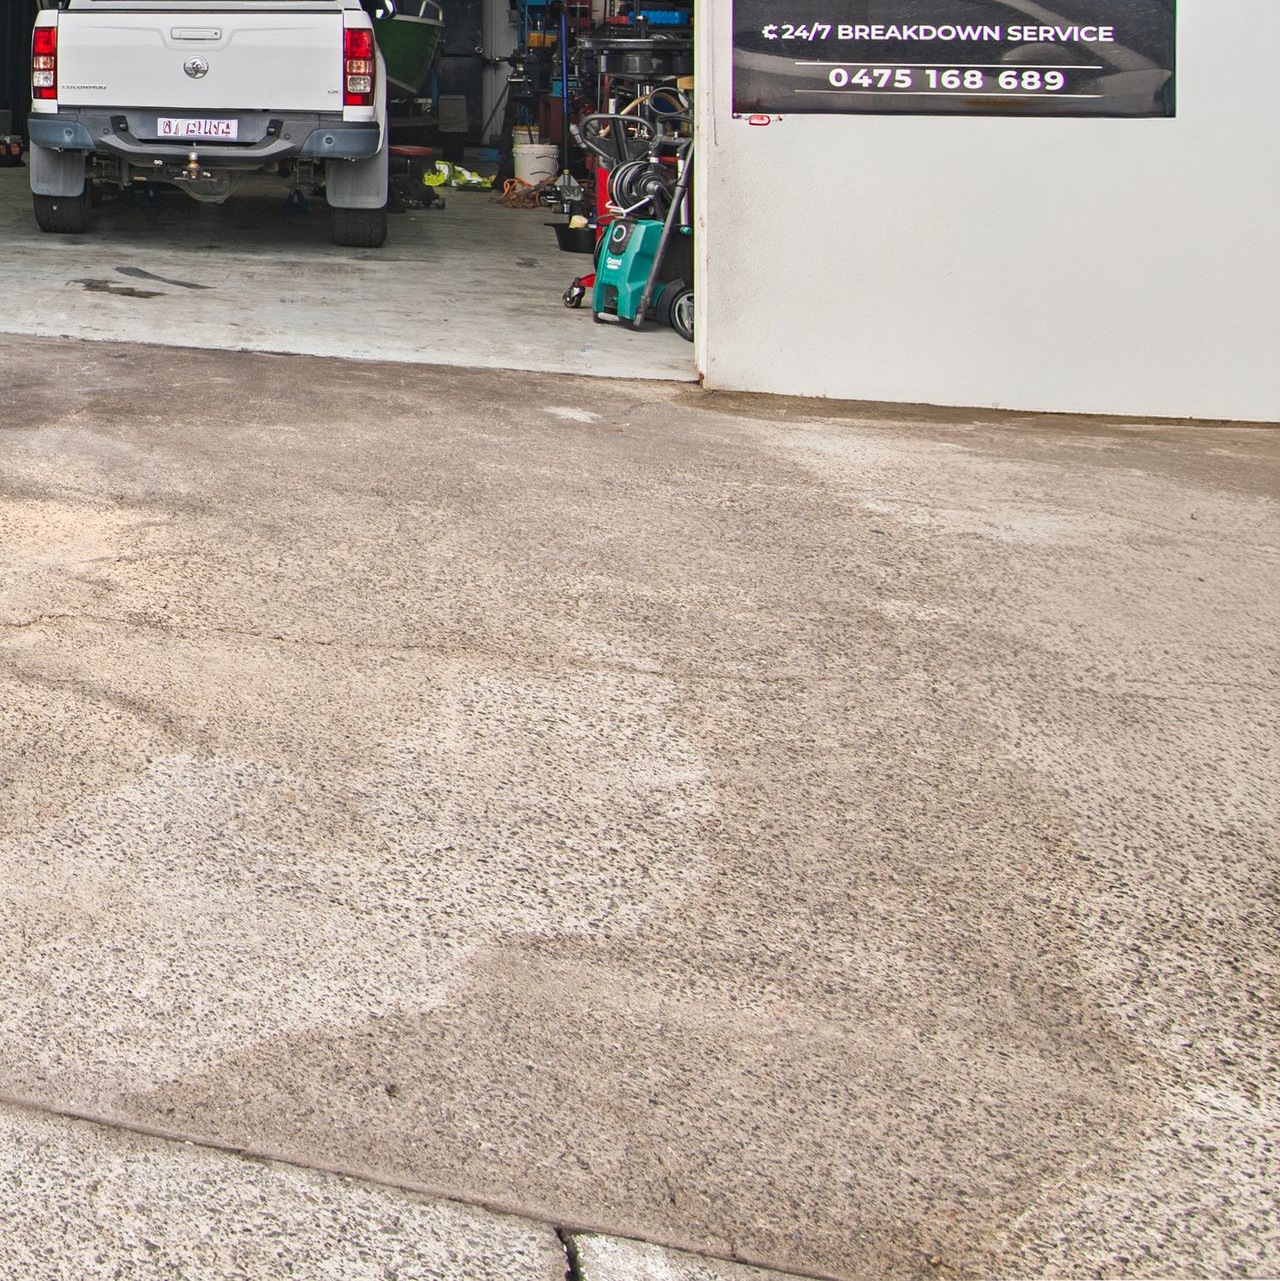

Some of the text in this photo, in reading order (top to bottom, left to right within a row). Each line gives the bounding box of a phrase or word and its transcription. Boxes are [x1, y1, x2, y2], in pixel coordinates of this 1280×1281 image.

[782, 22, 1113, 41] 24/7 BREAKDOWN SERVICE
[829, 68, 1064, 90] 0475 168 689
